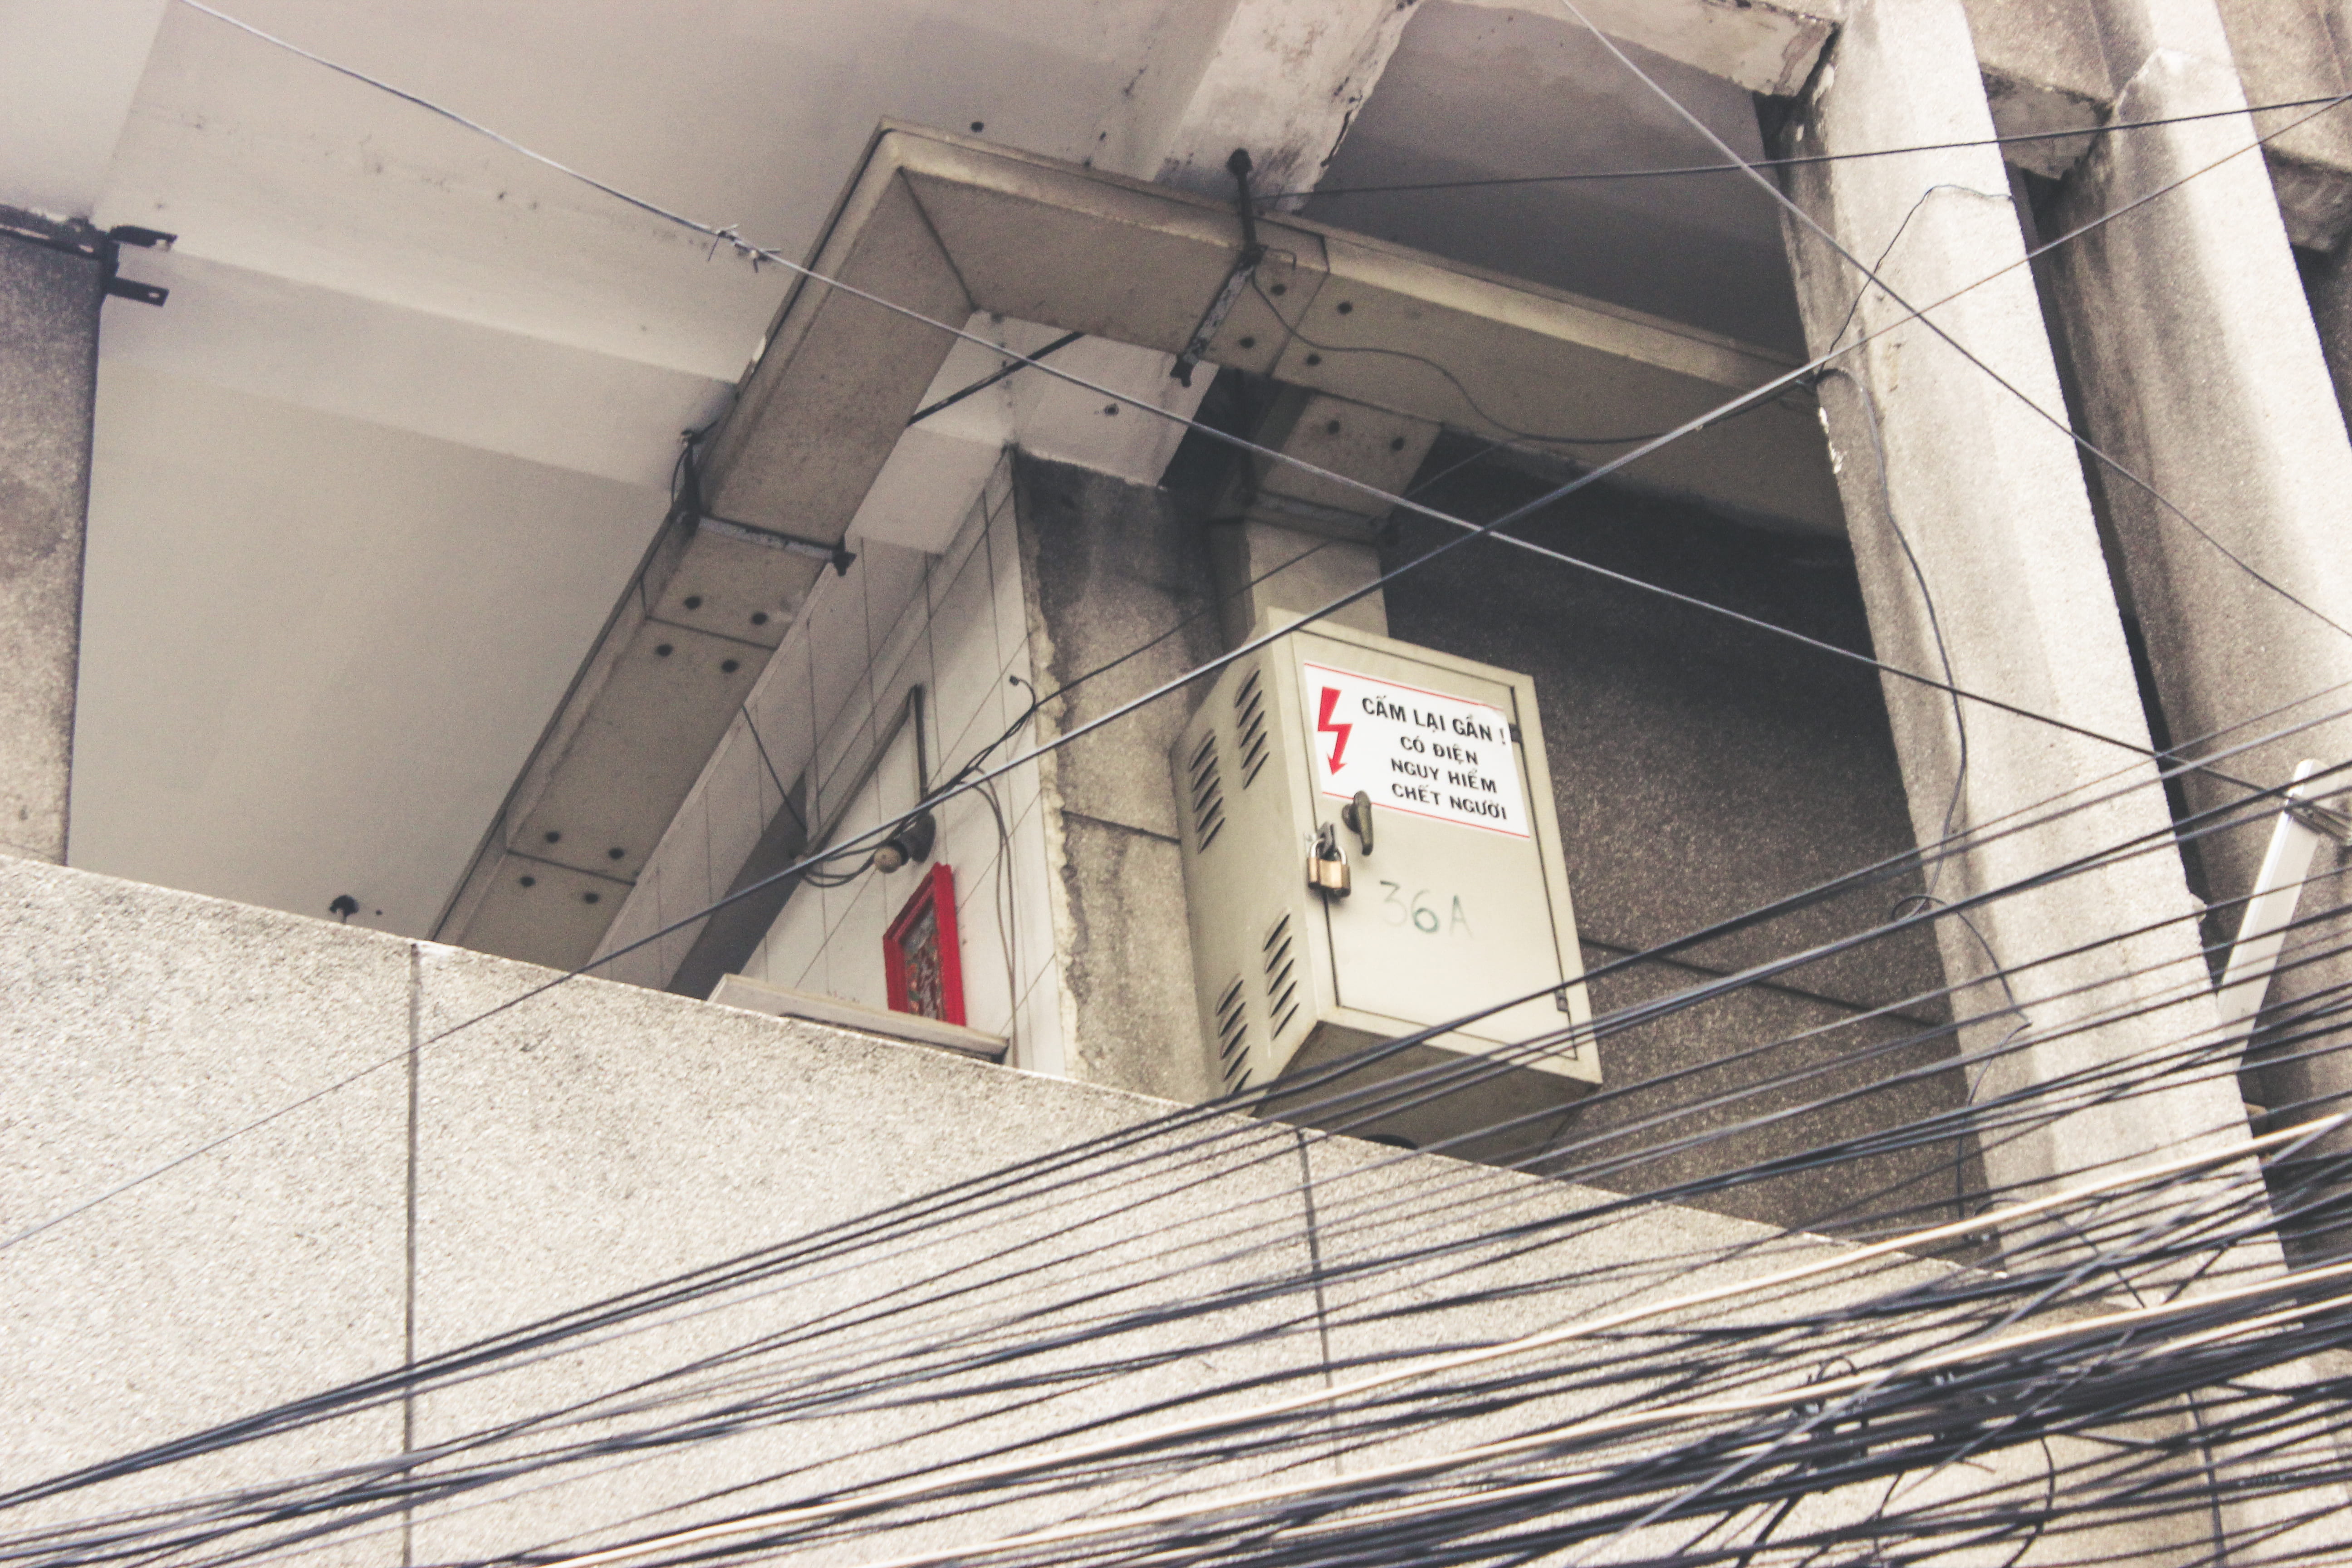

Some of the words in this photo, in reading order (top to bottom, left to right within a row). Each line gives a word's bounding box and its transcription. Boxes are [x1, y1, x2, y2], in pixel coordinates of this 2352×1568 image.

[1362, 695, 1406, 722] CẤM
[1413, 709, 1446, 733] LẠI
[1400, 736, 1425, 753] CÓ
[1432, 744, 1478, 765] ĐIỆN
[1391, 758, 1440, 780] NGUY
[1448, 769, 1497, 793] HIỂM
[1392, 783, 1441, 805] CHẾT
[1450, 795, 1507, 819] NGƯỜI
